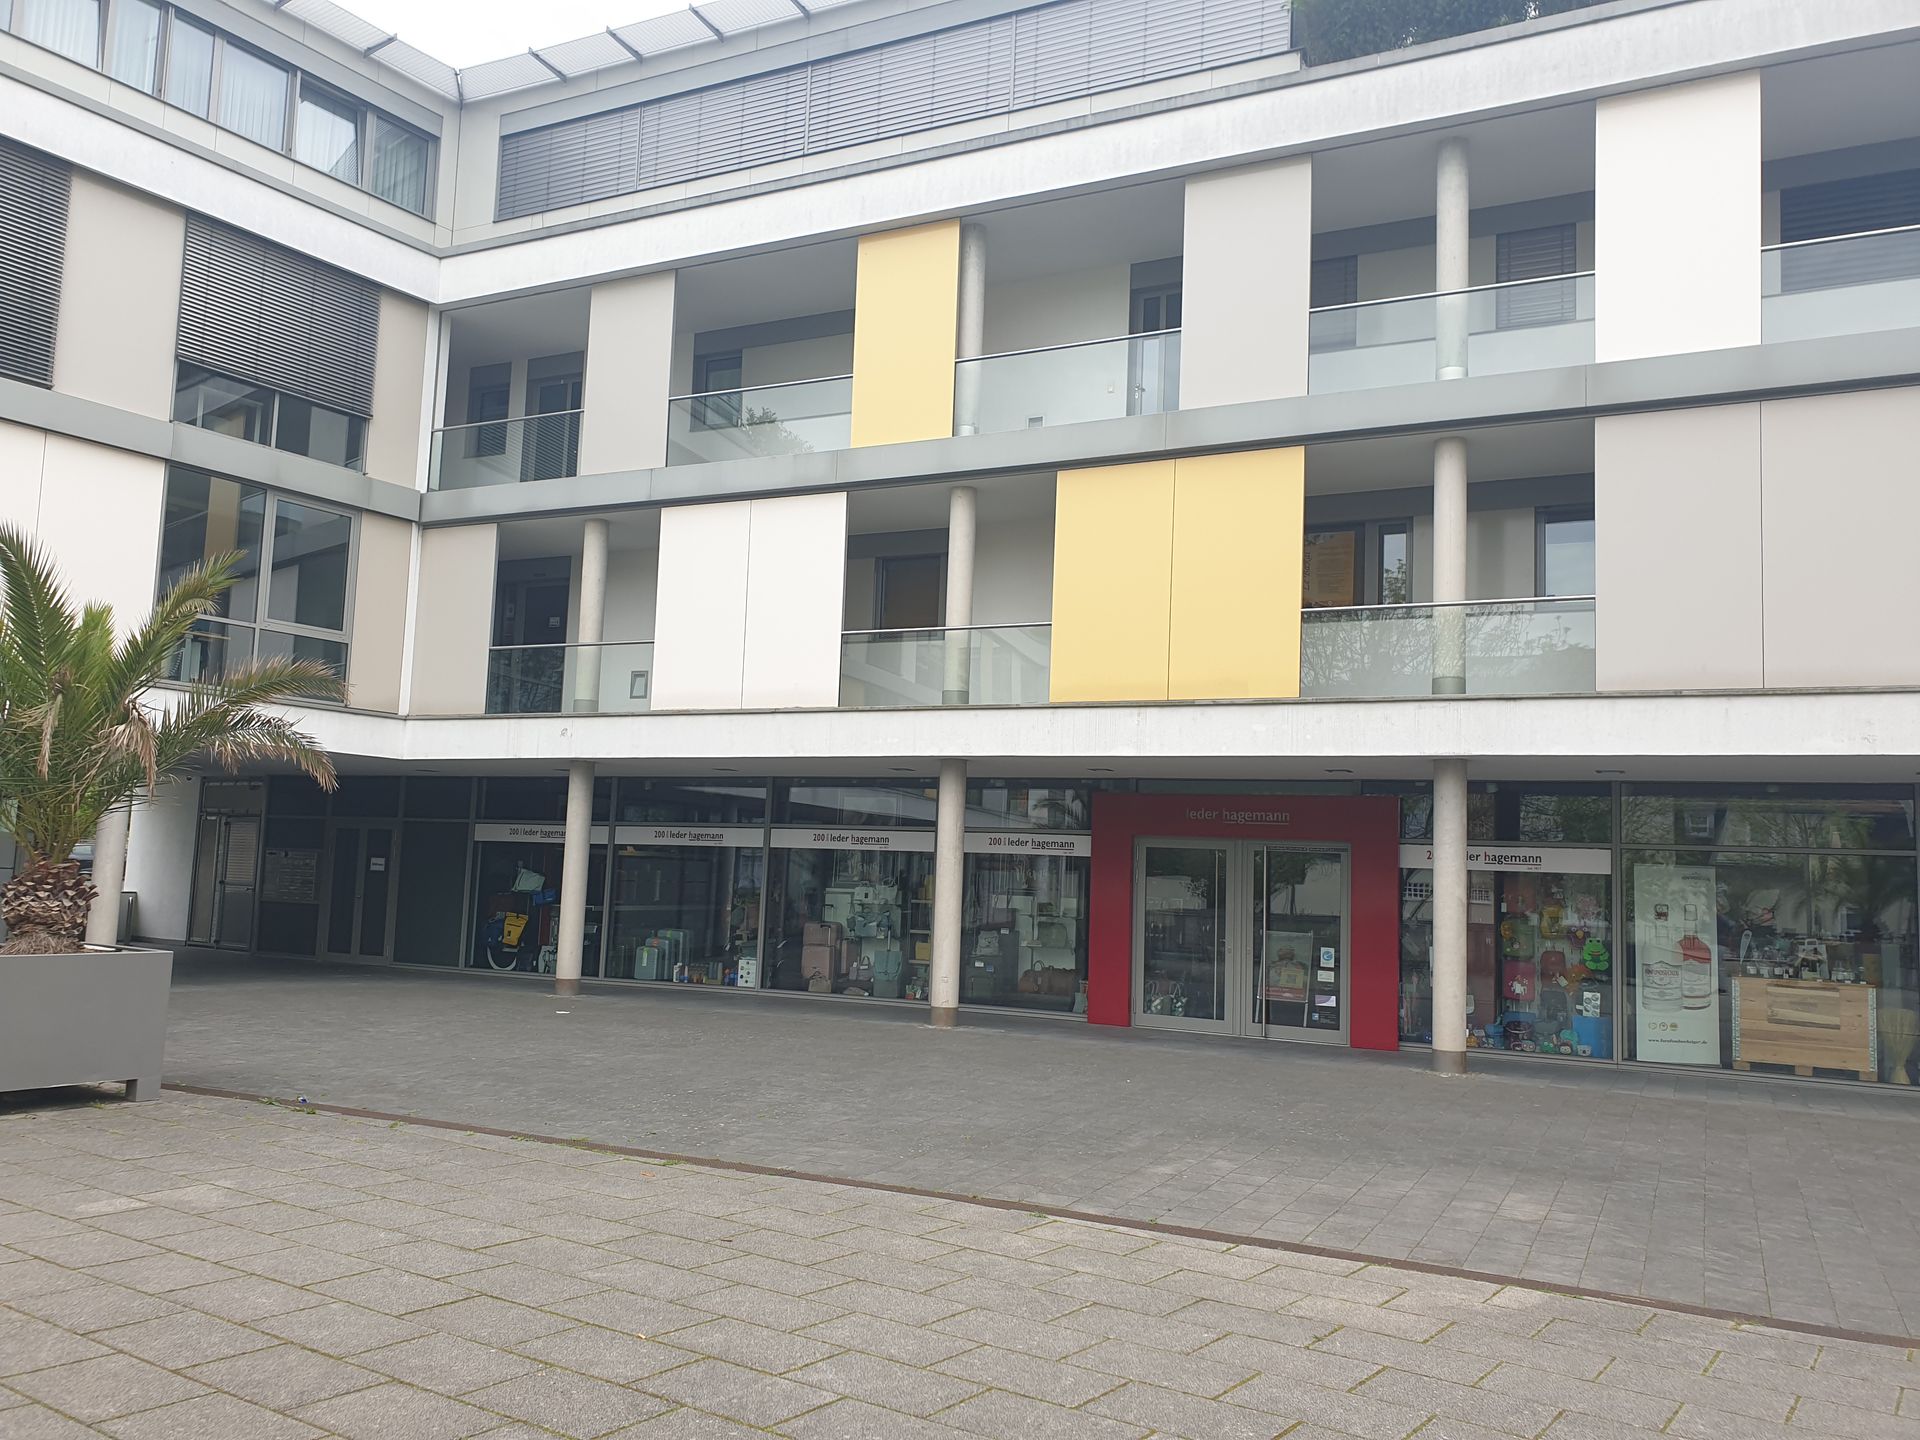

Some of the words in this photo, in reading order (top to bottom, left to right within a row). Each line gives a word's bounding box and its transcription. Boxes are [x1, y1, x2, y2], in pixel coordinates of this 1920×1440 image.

[1186, 808, 1219, 819] leder
[1223, 808, 1290, 824] hagemann
[509, 827, 519, 836] 200
[523, 827, 539, 836] leder
[654, 830, 665, 838] 200
[670, 830, 687, 838] leder
[689, 831, 723, 841] hagemann
[813, 833, 825, 841] 200
[830, 833, 849, 842] leder
[851, 834, 889, 845] hagemann
[988, 837, 1001, 845] 200
[1008, 837, 1029, 846] leder
[1031, 838, 1074, 850] hagemann
[1485, 851, 1541, 865] hagemann
